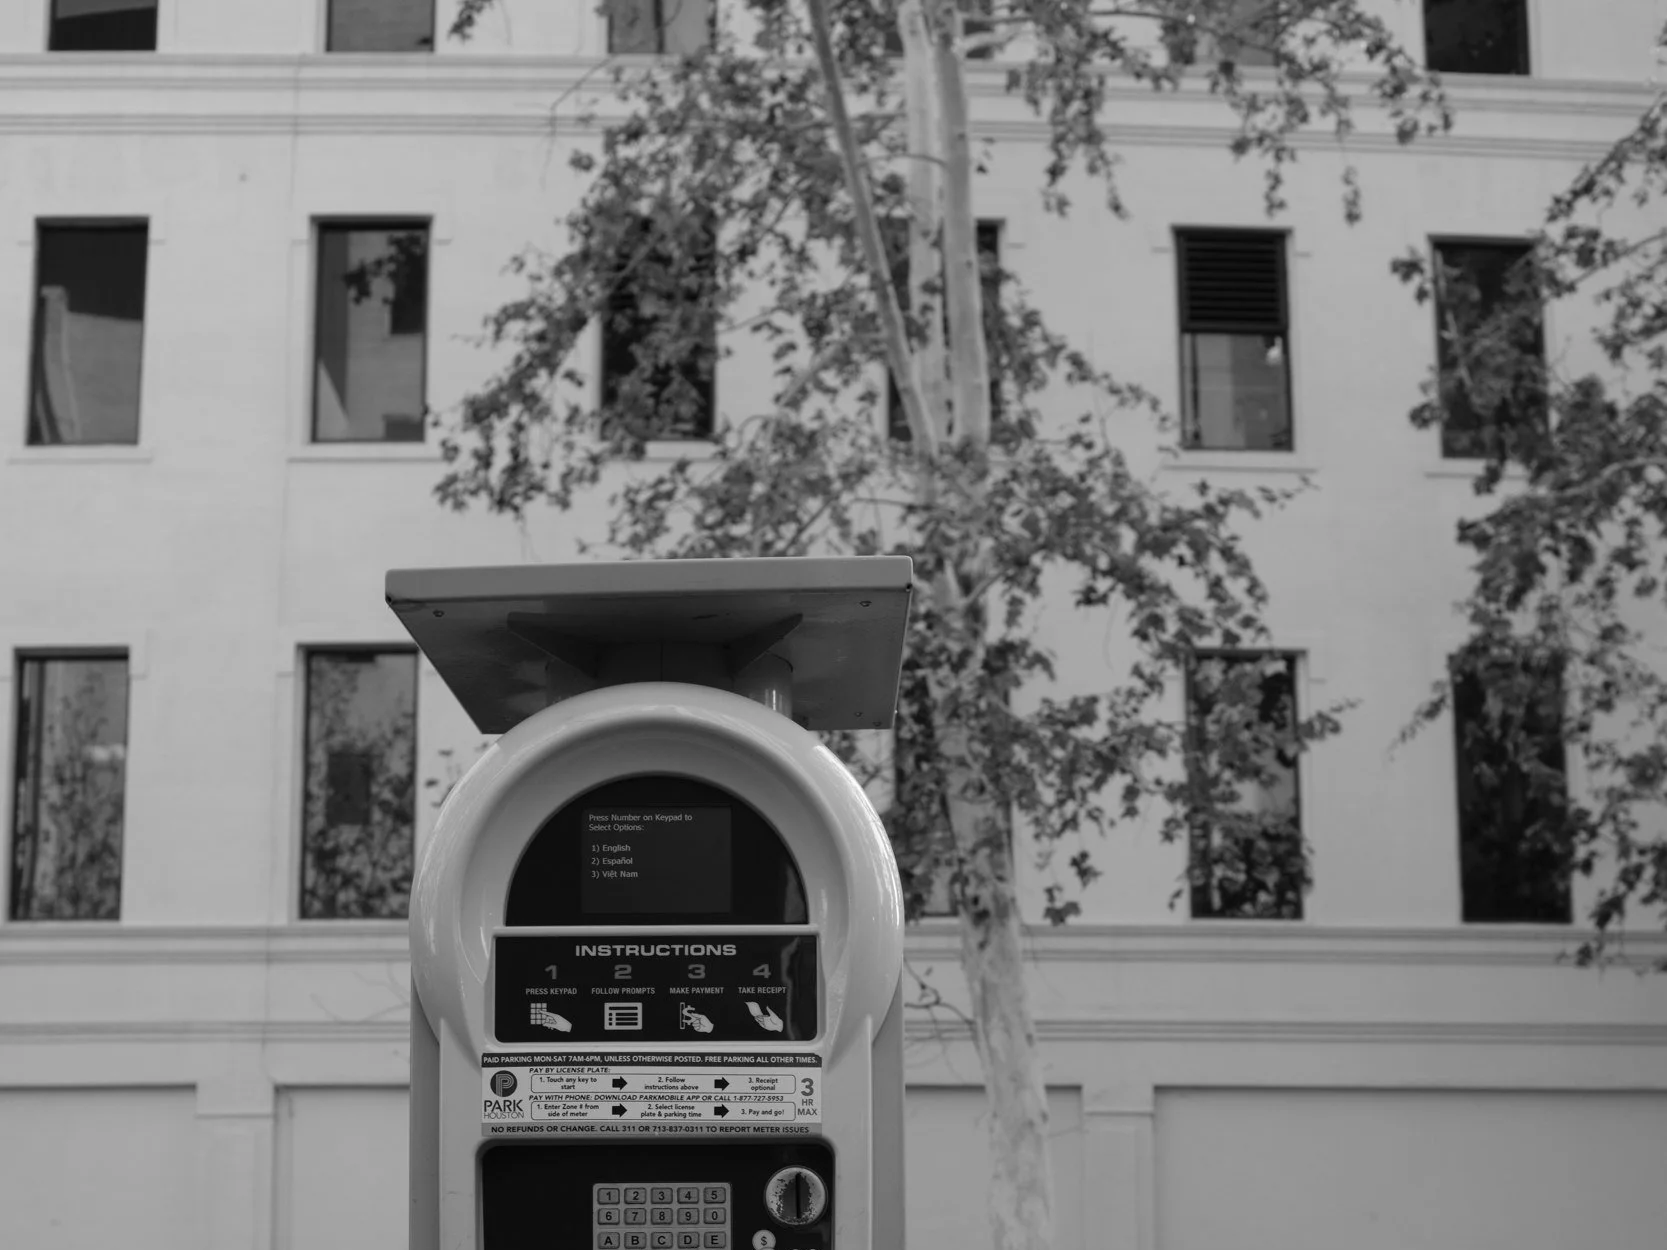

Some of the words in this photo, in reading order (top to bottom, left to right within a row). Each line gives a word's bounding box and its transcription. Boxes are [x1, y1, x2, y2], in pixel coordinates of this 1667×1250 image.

[589, 814, 609, 822] Press
[655, 814, 683, 822] Keypad
[589, 823, 611, 831] Select
[613, 823, 644, 832] Options:
[592, 844, 600, 853] 1)
[602, 844, 631, 853] English
[591, 857, 600, 866] 2)
[602, 857, 633, 866] Español
[592, 870, 600, 879] 3)
[620, 870, 638, 878] Nam
[576, 944, 737, 956] INSTRUCTIONS
[545, 965, 557, 980] 1
[614, 964, 632, 979] 2
[688, 964, 706, 979] 3
[753, 964, 771, 979] 4
[622, 987, 656, 995] PROMPTS
[757, 986, 787, 994] RECEIPT
[533, 1055, 567, 1063] MON-SAT
[632, 1055, 672, 1063] OTHERWISE
[795, 1056, 817, 1064] TIMES.
[578, 1076, 589, 1084] key
[756, 1077, 778, 1085] Receipt
[751, 1084, 776, 1092] optional
[801, 1078, 814, 1097] 3
[484, 1099, 523, 1113] PARK
[801, 1098, 814, 1106] HR
[483, 1111, 524, 1119] HOUSTON
[664, 1111, 687, 1119] parking
[748, 1109, 760, 1117] Pay
[797, 1108, 818, 1116] MAX
[506, 1125, 544, 1133] REFUNDS
[782, 1126, 809, 1134] ISSUES
[606, 1191, 611, 1201] 1
[632, 1191, 639, 1201] 2
[658, 1191, 665, 1201] 3
[685, 1191, 692, 1201] 4
[711, 1190, 718, 1200] 5
[605, 1211, 612, 1221] 6
[632, 1211, 639, 1221] 7
[659, 1211, 665, 1221] 8
[685, 1211, 692, 1221] 9
[711, 1211, 718, 1222] 0
[604, 1236, 613, 1246] A
[631, 1235, 640, 1245] B
[657, 1235, 666, 1245] C
[684, 1235, 692, 1245] D
[711, 1235, 719, 1245] E
